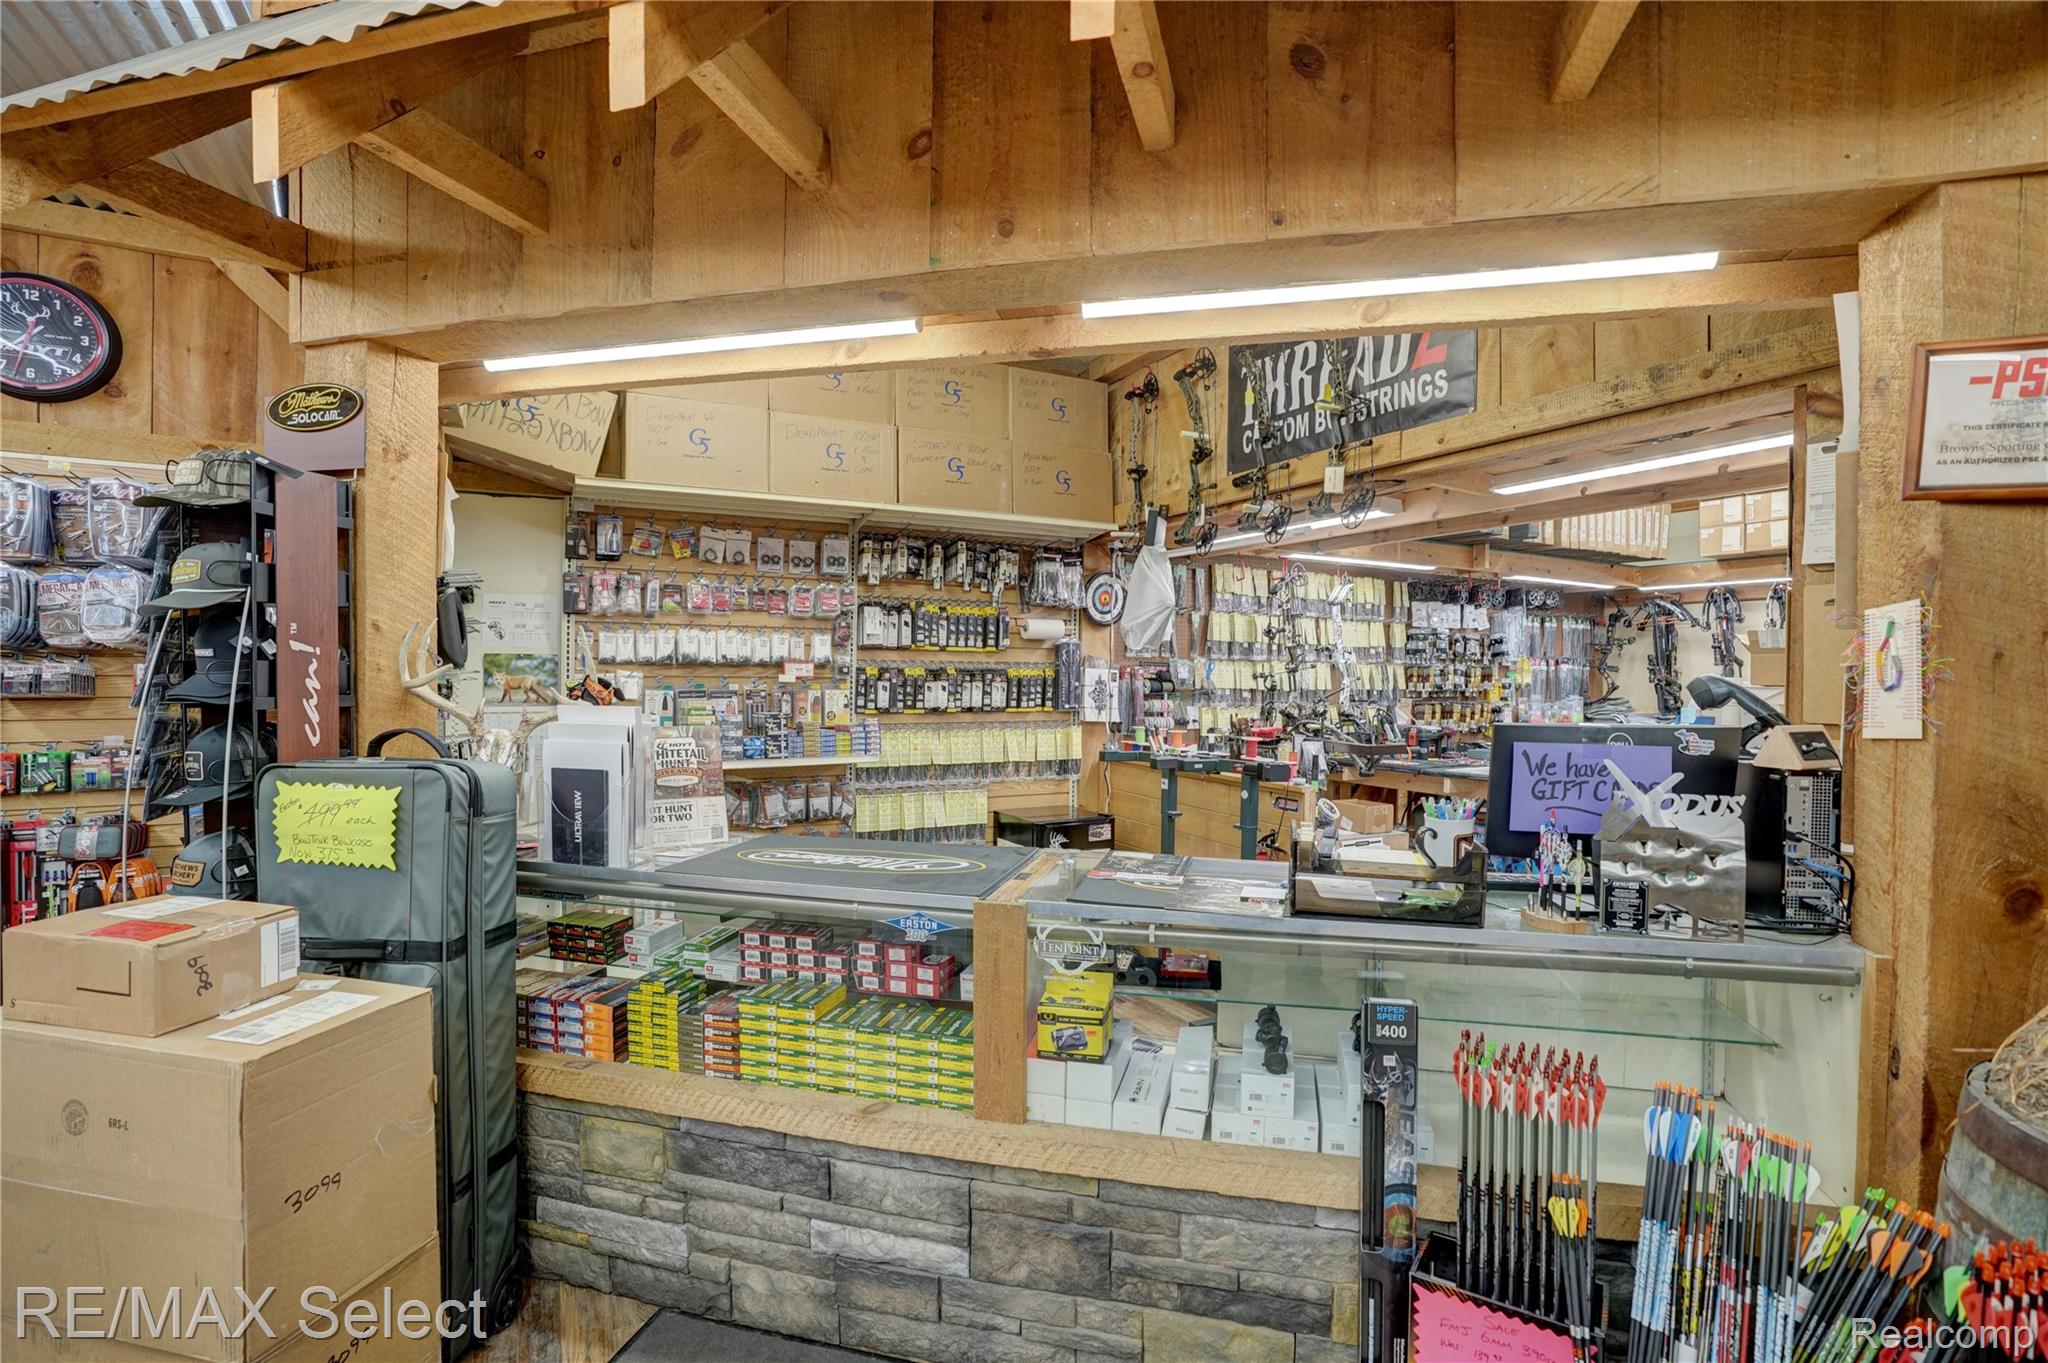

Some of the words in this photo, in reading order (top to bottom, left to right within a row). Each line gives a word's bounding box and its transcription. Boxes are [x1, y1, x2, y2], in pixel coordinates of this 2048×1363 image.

[22, 288, 40, 301] 12
[53, 300, 61, 310] 1
[73, 315, 83, 327] 2
[80, 336, 90, 346] 3
[72, 353, 82, 364] 4
[26, 367, 36, 378] 6
[279, 388, 341, 417] Mathews
[287, 410, 343, 425] SOLOCAM
[1985, 421, 2041, 430] CERTIFICATE
[1987, 441, 2040, 454] Sporting
[1964, 457, 2020, 466] AUTHORIZED
[2022, 455, 2040, 463] PSE
[660, 759, 692, 768] HUNT
[1522, 750, 1557, 777] We
[1566, 752, 1611, 778] have
[655, 768, 698, 777] GIVEAWAY
[1531, 779, 1589, 802] GIFT
[664, 804, 693, 813] HUNT
[345, 815, 376, 825] each
[667, 813, 693, 822] TWO
[900, 919, 938, 930] EASTON
[1376, 1005, 1408, 1014] HYPER-
[1376, 1013, 1405, 1022] SPEED
[1381, 1025, 1407, 1039] 400
[284, 1172, 342, 1214] 3099
